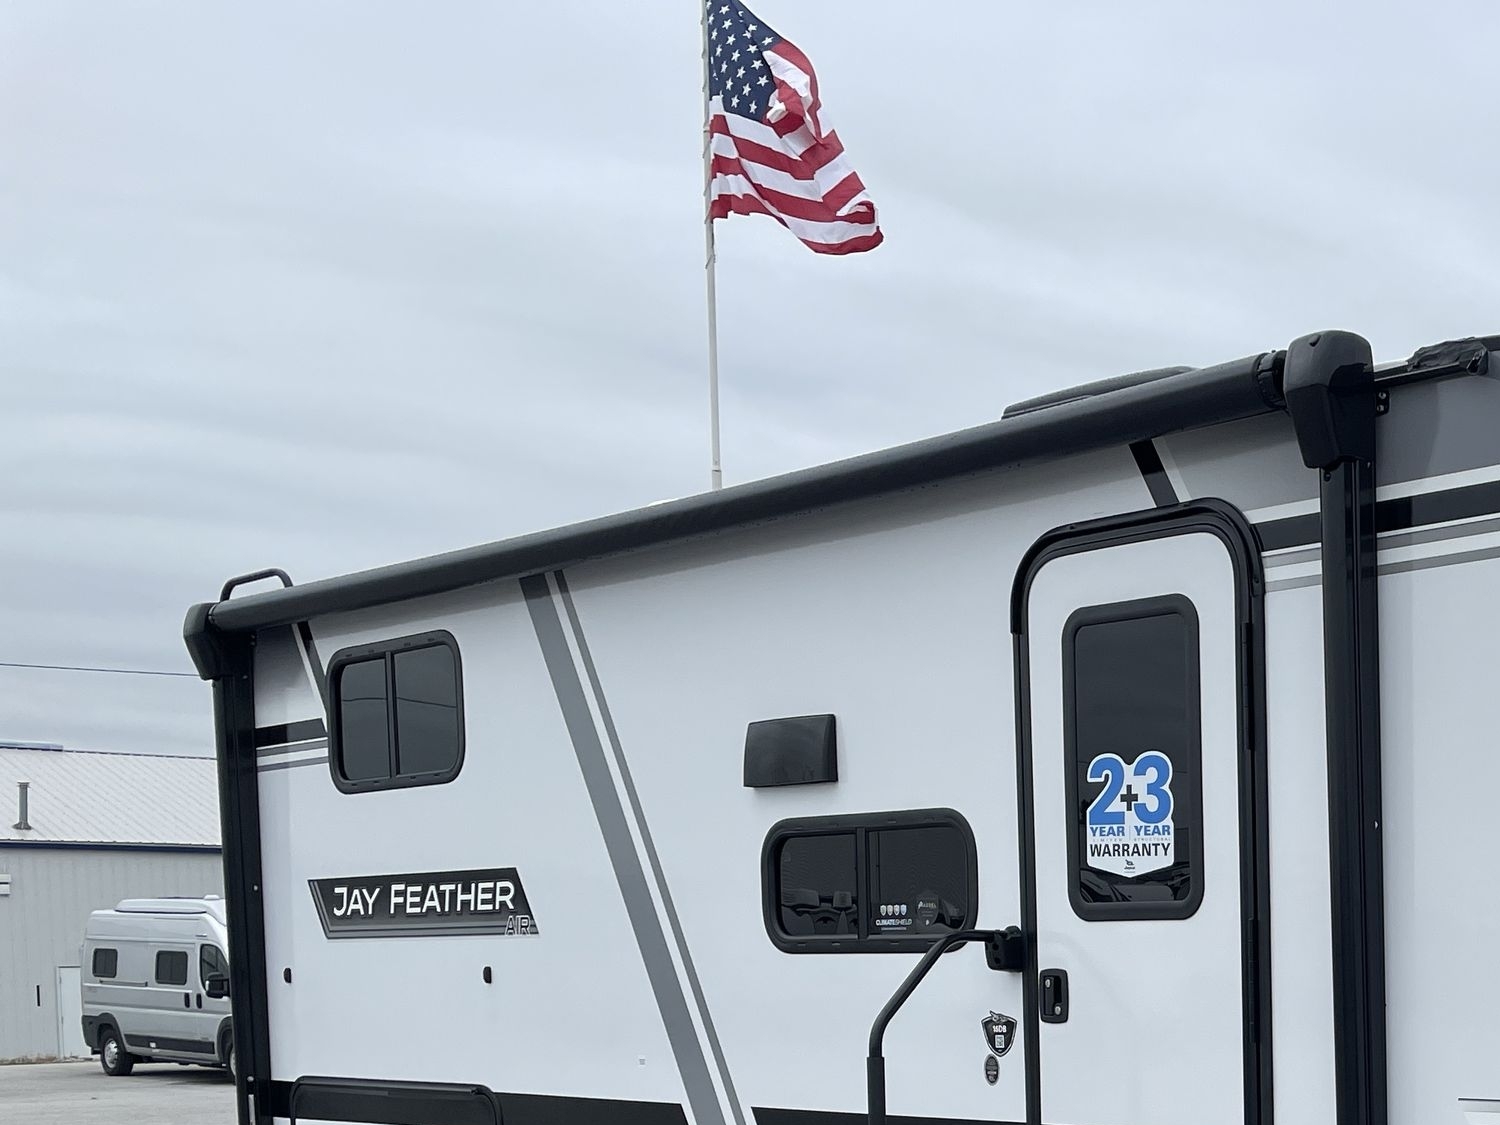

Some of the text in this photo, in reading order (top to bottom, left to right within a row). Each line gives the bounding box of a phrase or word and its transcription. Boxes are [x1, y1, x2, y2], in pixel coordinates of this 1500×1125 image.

[1090, 825, 1171, 837] YEAR YEAR
[1090, 842, 1171, 857] WARRANTY
[333, 881, 515, 917] JAY FEATHER
[504, 914, 532, 936] AIR
